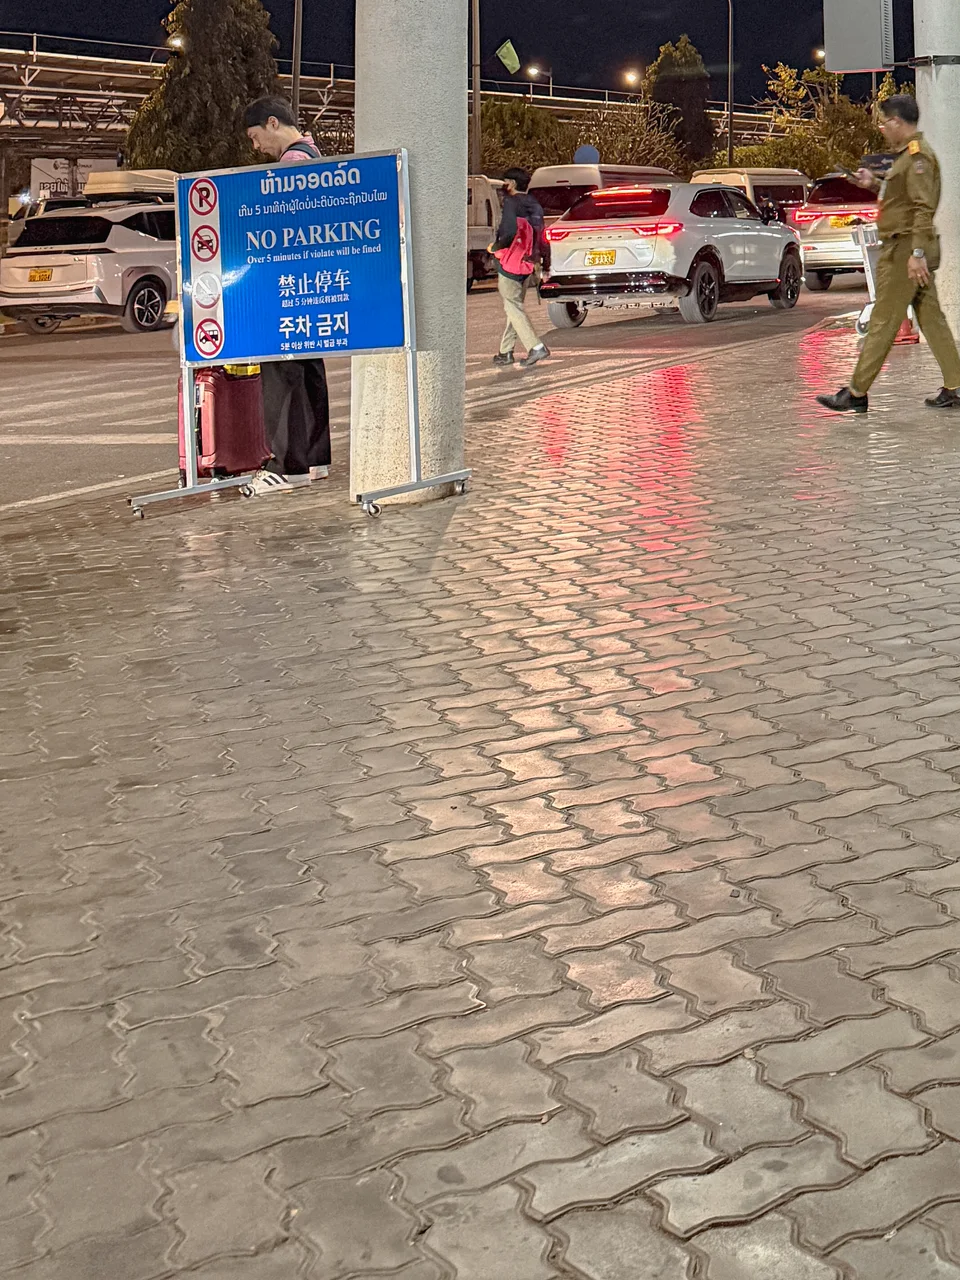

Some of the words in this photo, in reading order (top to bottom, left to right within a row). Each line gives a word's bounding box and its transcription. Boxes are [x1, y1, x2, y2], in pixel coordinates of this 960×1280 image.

[260, 162, 361, 195] ຫ້າມຈອດລົດ
[255, 206, 261, 215] 5
[246, 229, 277, 251] NO
[282, 218, 381, 248] PARKING
[247, 255, 265, 264] Over
[266, 253, 271, 263] 5
[273, 251, 302, 262] minutes
[303, 250, 309, 259] if
[309, 248, 335, 258] violate
[336, 246, 350, 255] will
[351, 245, 361, 255] be
[362, 243, 382, 253] fined
[278, 268, 352, 298] 禁止停车
[295, 298, 300, 306] 5
[278, 314, 313, 339] 주차
[315, 311, 350, 337] 금지
[280, 342, 291, 351] 5분
[291, 341, 303, 350] 이상
[304, 340, 316, 349] 위반
[316, 340, 323, 348] 시
[323, 339, 335, 348] 벌금
[336, 338, 348, 347] 부과
